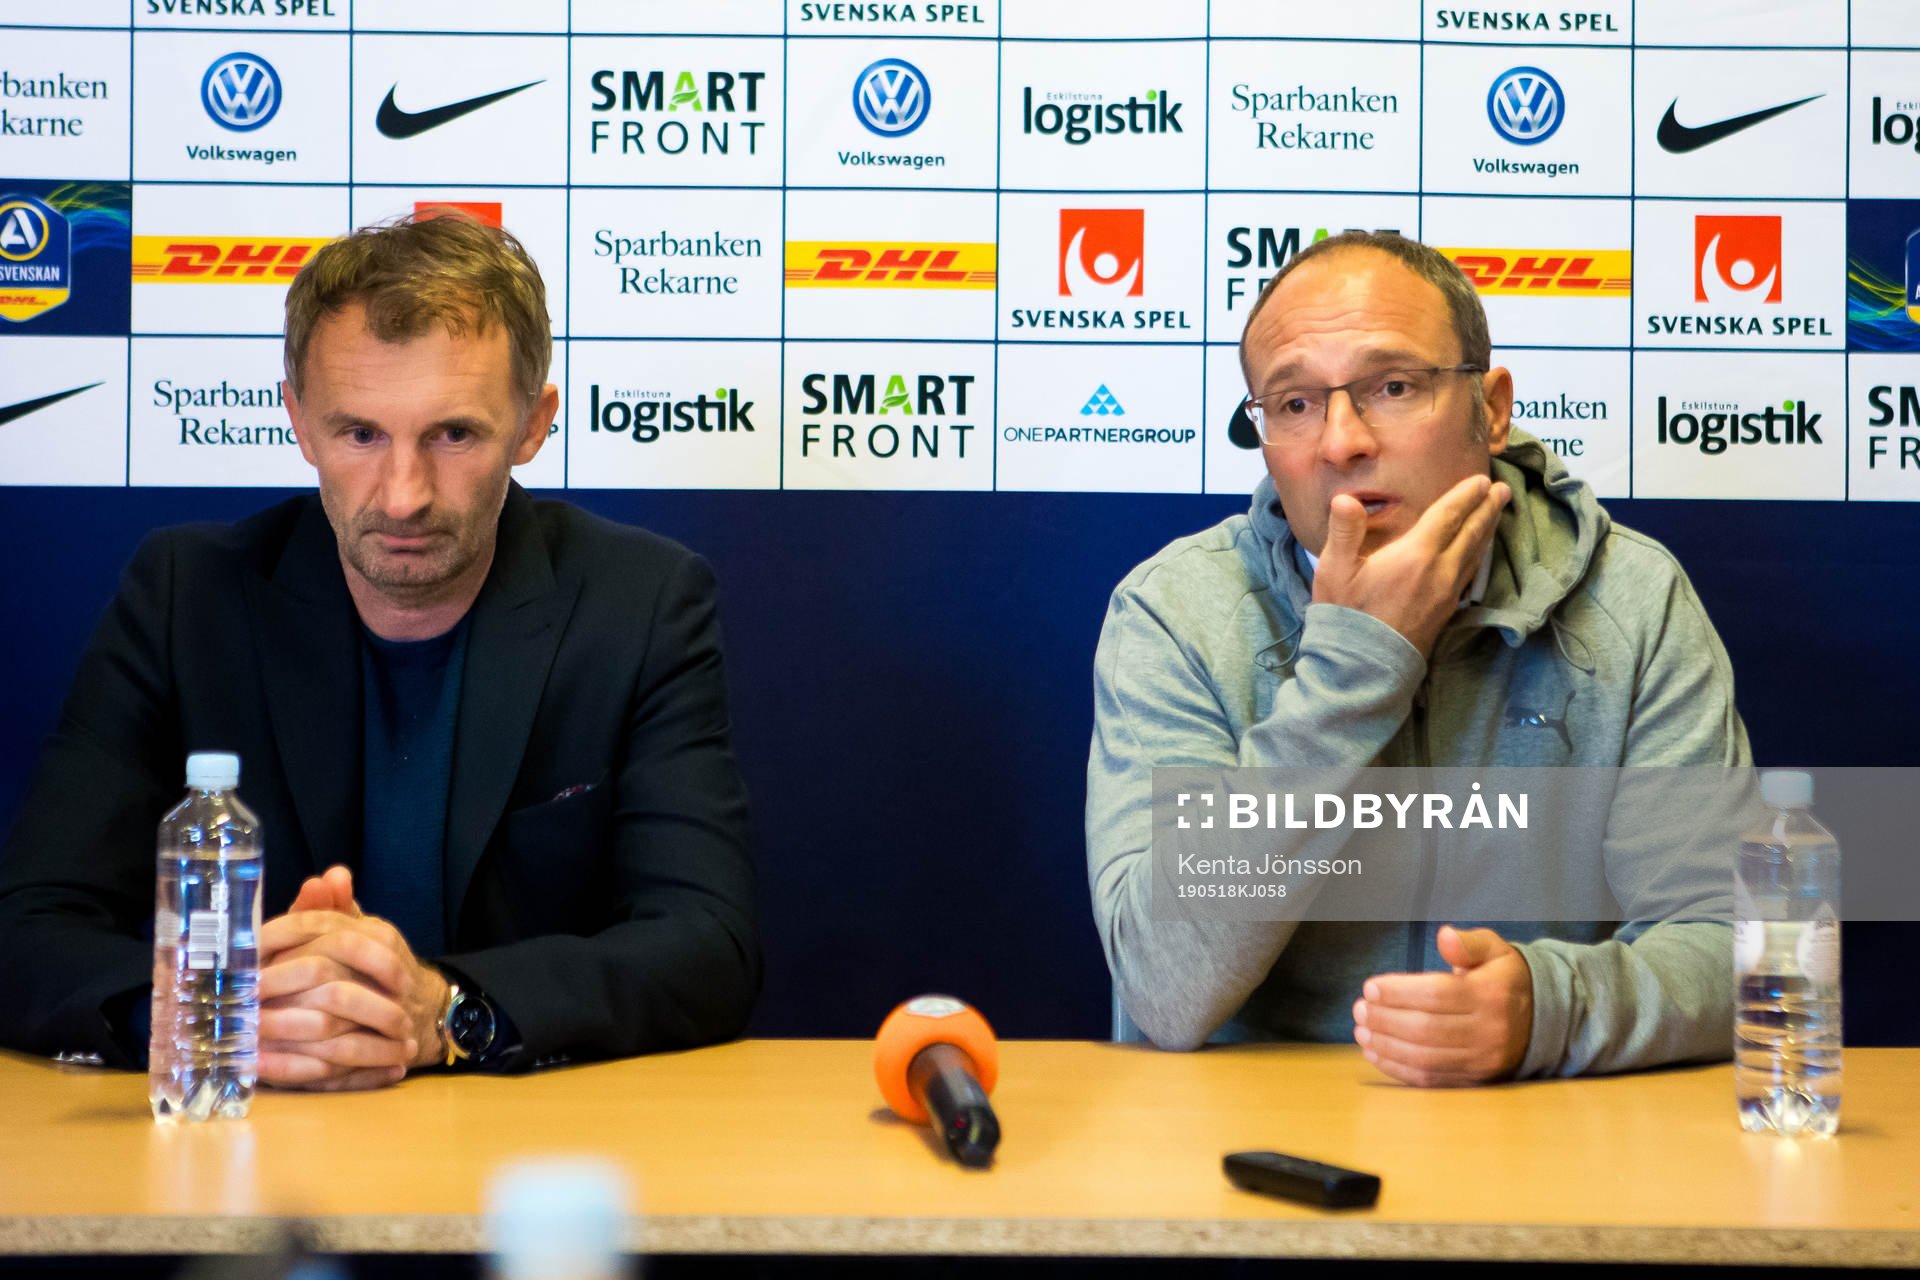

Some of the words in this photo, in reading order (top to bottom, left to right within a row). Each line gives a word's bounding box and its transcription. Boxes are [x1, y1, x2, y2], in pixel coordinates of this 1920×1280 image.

[147, 0, 265, 15] SVENSKA
[275, 0, 336, 16] SPEL
[801, 2, 916, 22] SVENSKA
[926, 4, 985, 23] SPEL
[1436, 10, 1550, 30] SVENSKA
[1559, 12, 1619, 32] SPEL
[0, 71, 107, 98] banken
[590, 70, 766, 112] SMART
[1047, 92, 1103, 101] Eskilstuna
[1023, 86, 1184, 145] logistik
[1231, 84, 1398, 119] Sparbanken
[1, 108, 83, 136] karne
[1257, 121, 1374, 151] Rekarne
[591, 120, 766, 155] FRONT
[186, 145, 297, 165] Volkswagen
[838, 151, 946, 170] Volkswagen
[1473, 158, 1580, 178] Volkswagen
[594, 229, 762, 264] Sparbanken
[0, 265, 60, 281] SVENSKAN
[619, 264, 738, 295] Rekarne
[814, 249, 968, 282] DHL
[1452, 255, 1604, 289] DHL
[1011, 309, 1126, 328] SVENSKA
[1133, 310, 1191, 329] SPEL
[1647, 315, 1764, 336] SVENSKA
[1772, 317, 1833, 337] SPEL
[801, 373, 976, 416] SMART
[1681, 401, 1739, 411] Eskilstuna
[590, 384, 756, 443] logistik
[1657, 395, 1824, 455] logistik
[178, 417, 299, 446] Rekarne
[801, 423, 975, 459] FRONT
